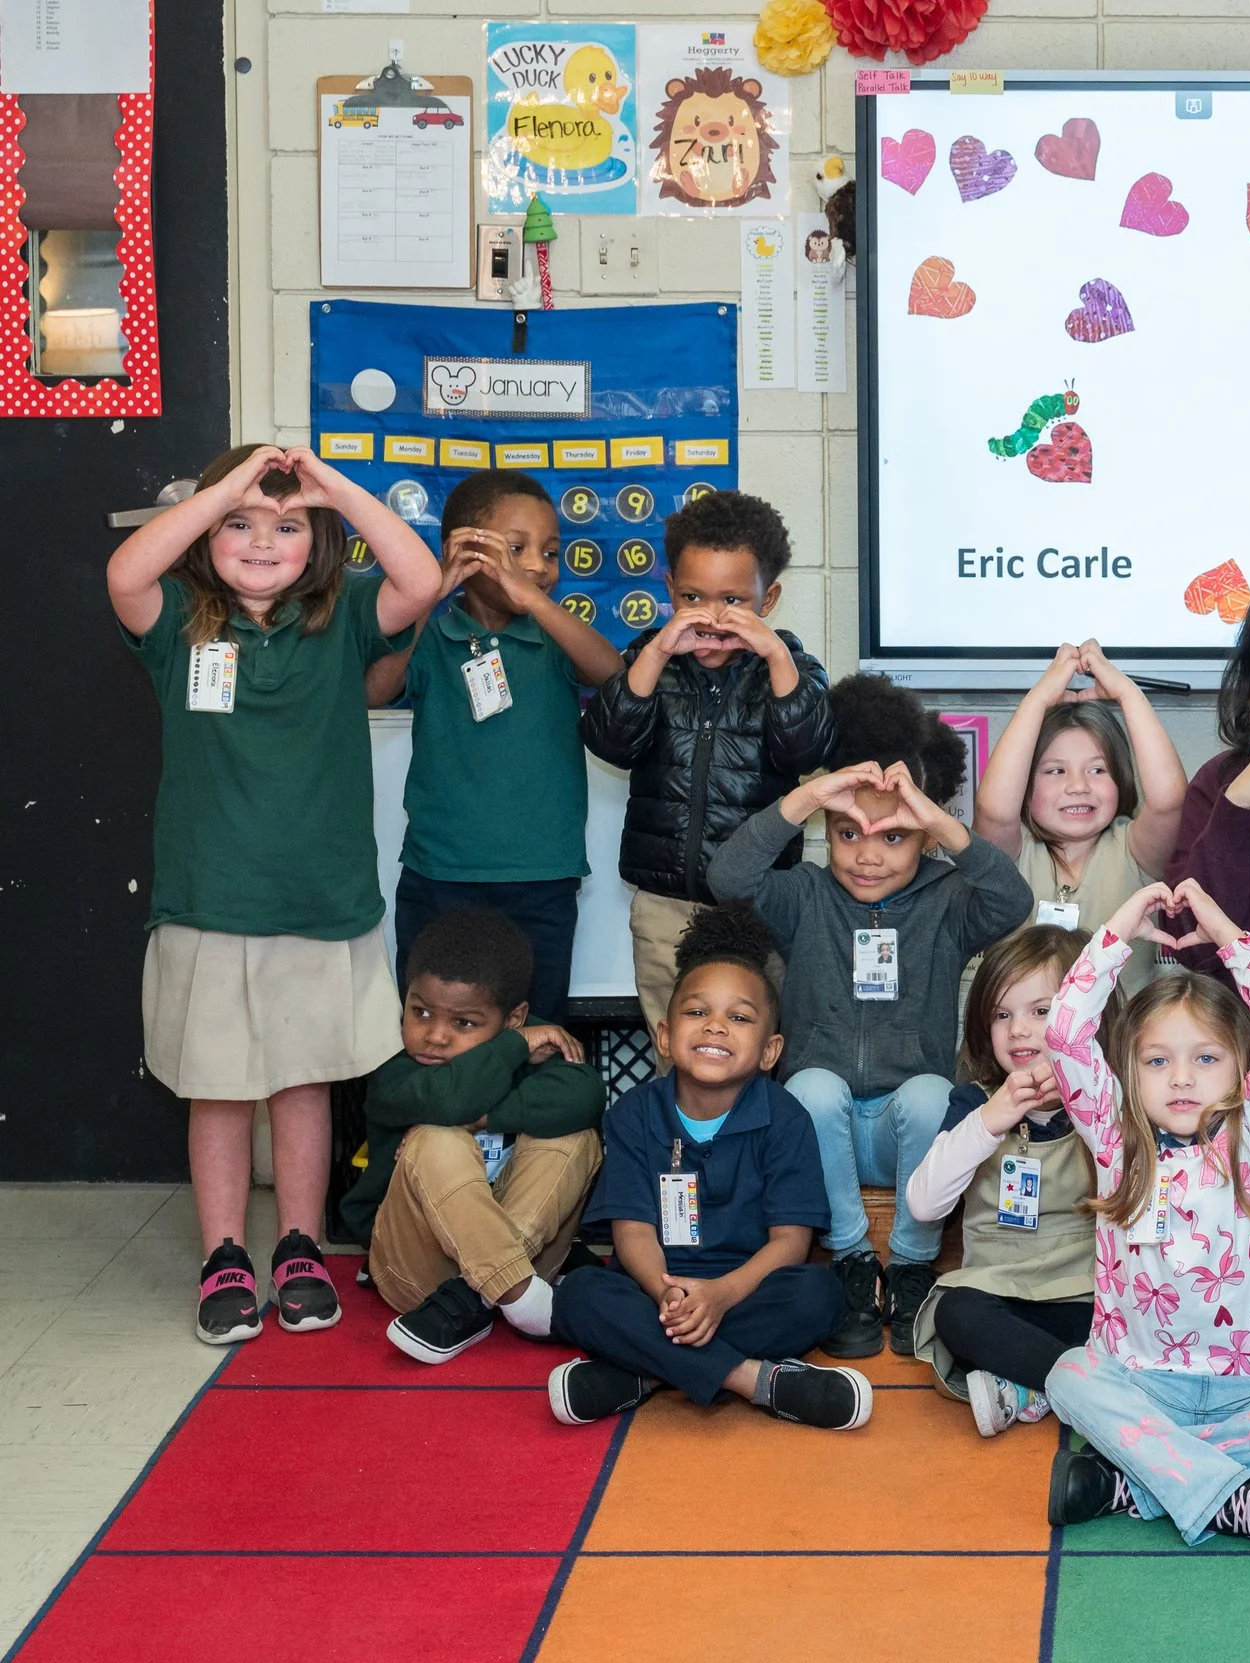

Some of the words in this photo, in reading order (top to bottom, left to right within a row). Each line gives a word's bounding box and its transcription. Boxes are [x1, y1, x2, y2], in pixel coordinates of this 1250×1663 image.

[493, 43, 566, 73] LUCKY
[688, 46, 740, 56] Heggerty
[511, 68, 562, 89] DUCK
[858, 70, 877, 80] Self
[884, 70, 906, 80] Talk
[951, 71, 967, 87] Say
[857, 82, 886, 93] Parallel
[889, 82, 909, 92] Talk
[673, 131, 745, 166] Zari
[479, 375, 578, 402] January
[334, 443, 358, 451] Sunday
[398, 445, 423, 454] Monday
[453, 448, 479, 459] Tuesday
[565, 450, 595, 460] Thursday
[625, 448, 647, 459] Friday
[686, 448, 717, 459] Saturday
[503, 452, 542, 462] Wednesday
[572, 493, 588, 514] 8
[628, 492, 645, 515] 9
[573, 546, 593, 568] 15
[623, 545, 647, 569] 16
[958, 546, 1024, 579] Eric
[1036, 546, 1132, 579] Carle
[564, 599, 591, 623] 22
[626, 598, 652, 621] 23
[688, 1182, 697, 1210] PINCH
[690, 1214, 699, 1236] CARD
[286, 1261, 315, 1278] NIKE
[214, 1271, 247, 1288] NIKE
